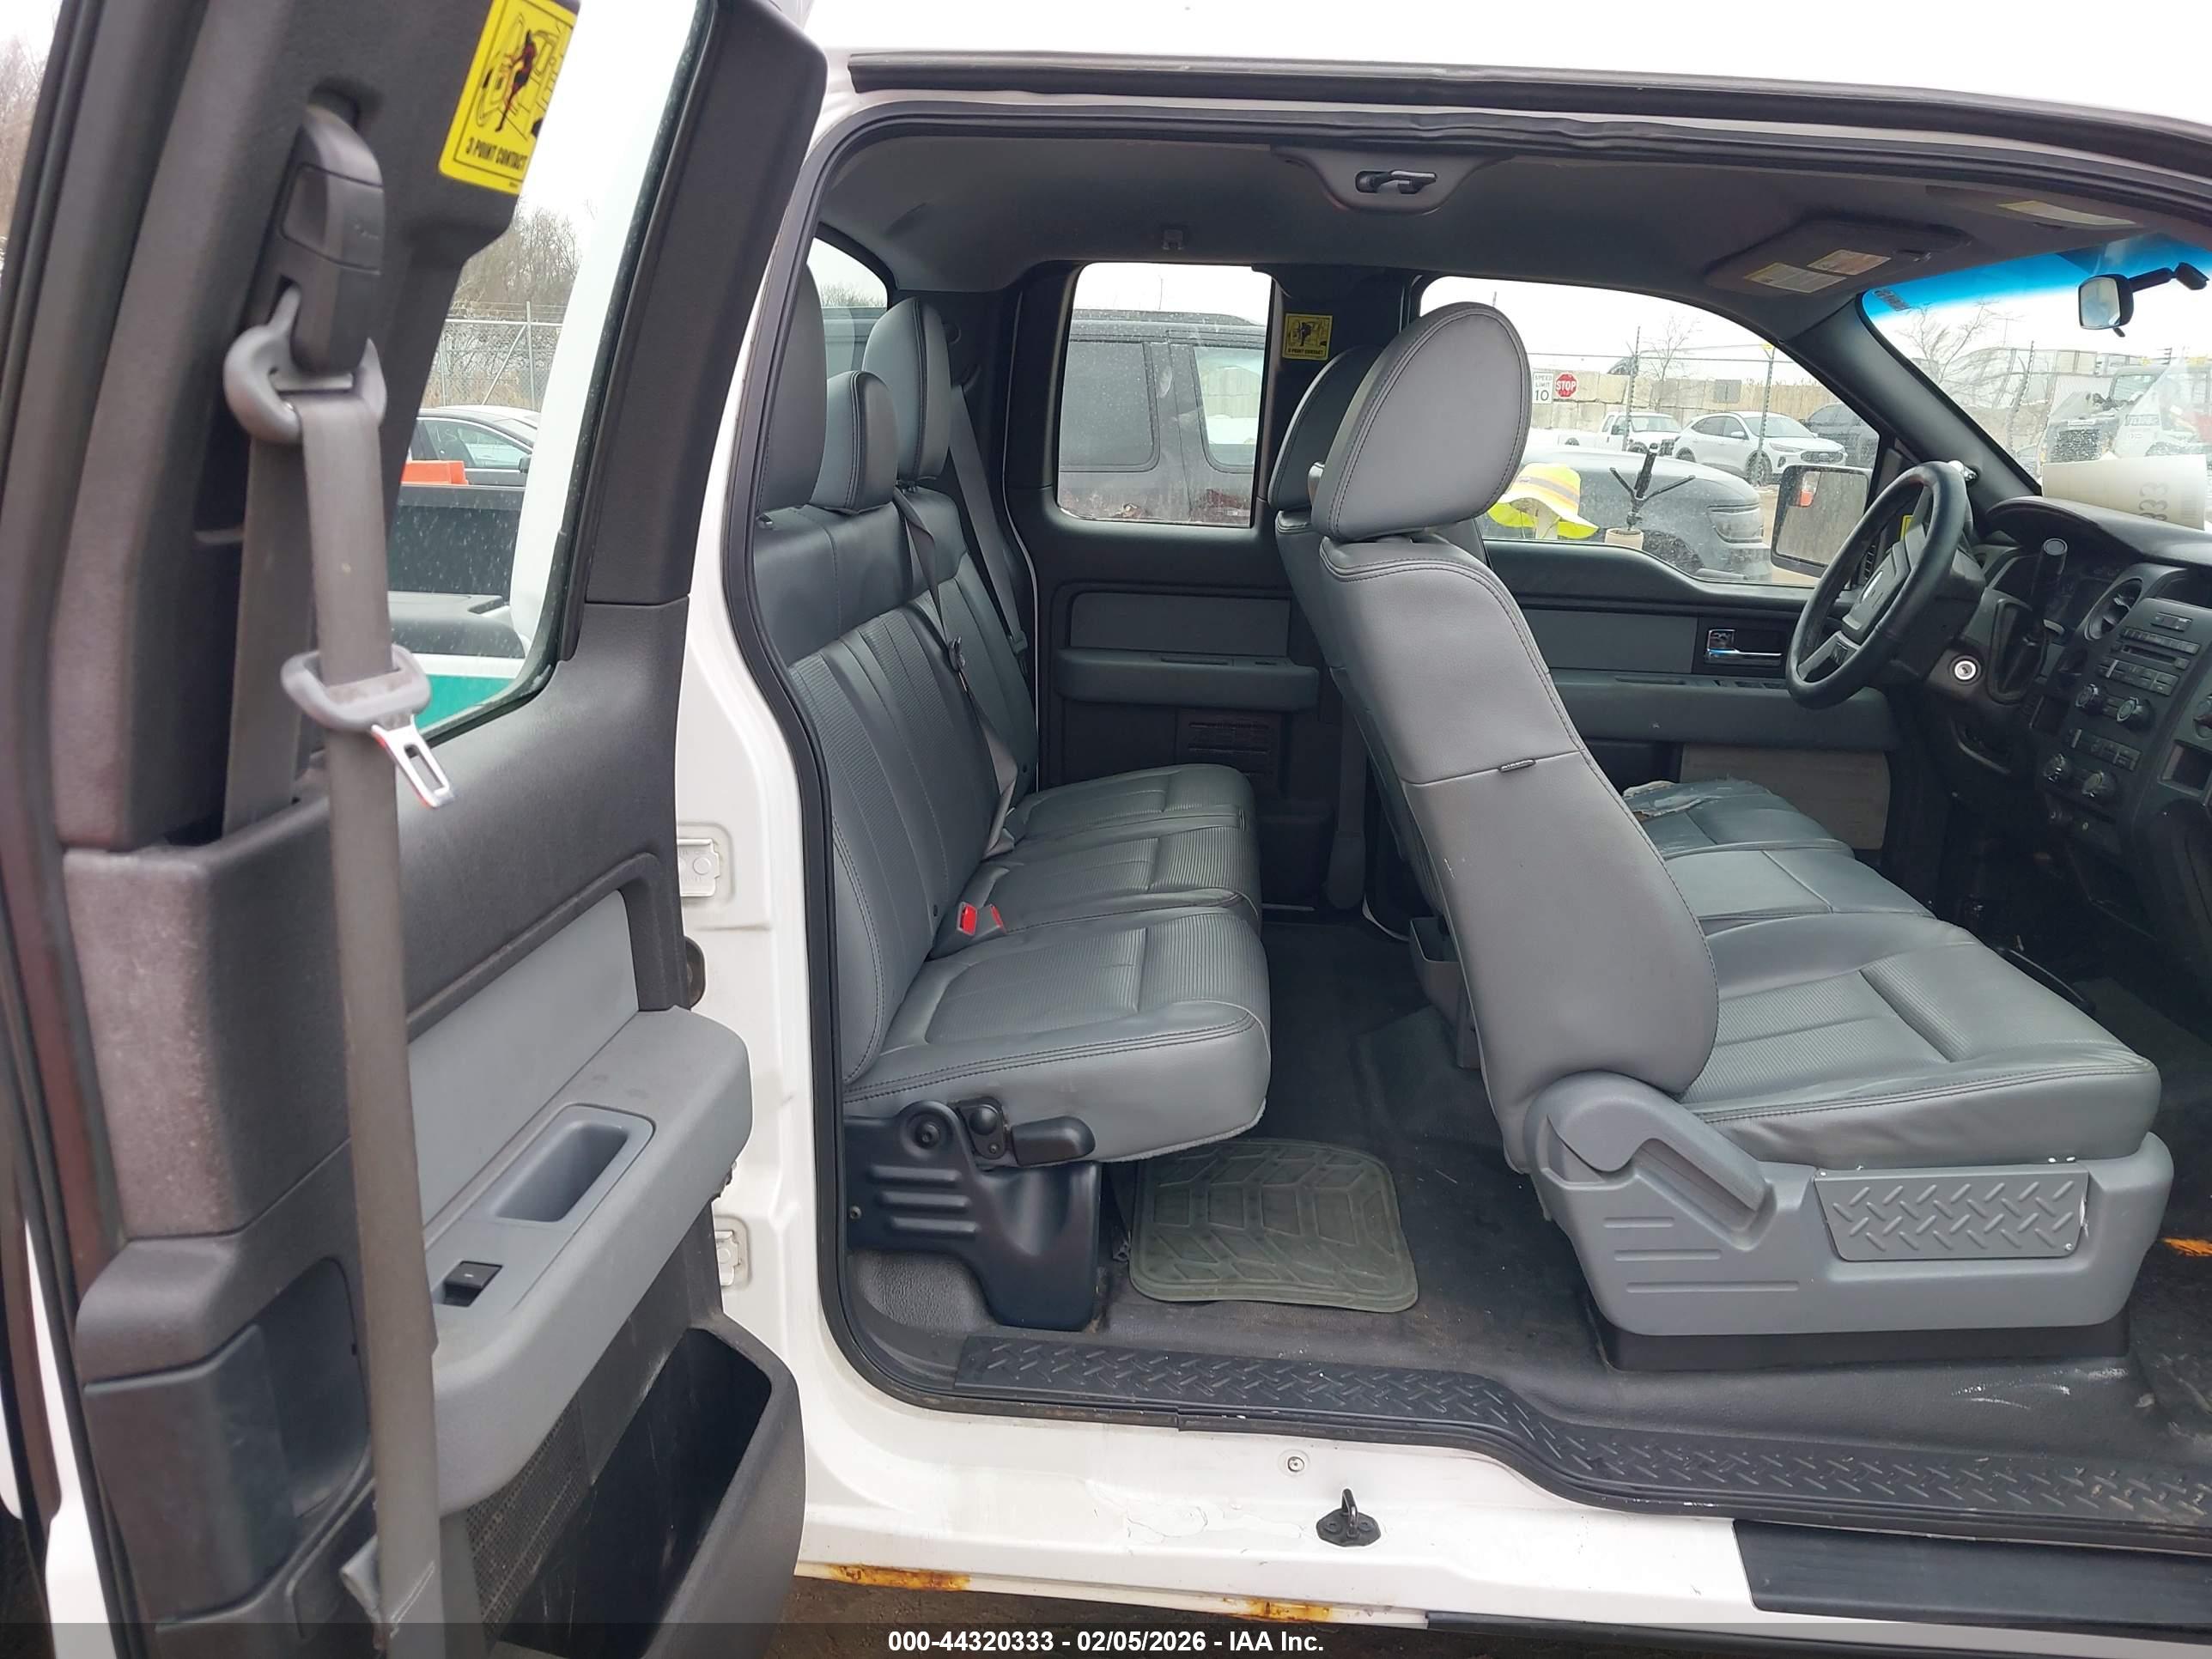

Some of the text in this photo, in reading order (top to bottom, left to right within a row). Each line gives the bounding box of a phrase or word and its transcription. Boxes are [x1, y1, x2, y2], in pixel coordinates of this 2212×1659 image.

[465, 137, 528, 171] 3 POINT CONTACT
[1556, 380, 1577, 392] STOP
[1535, 390, 1549, 401] 10
